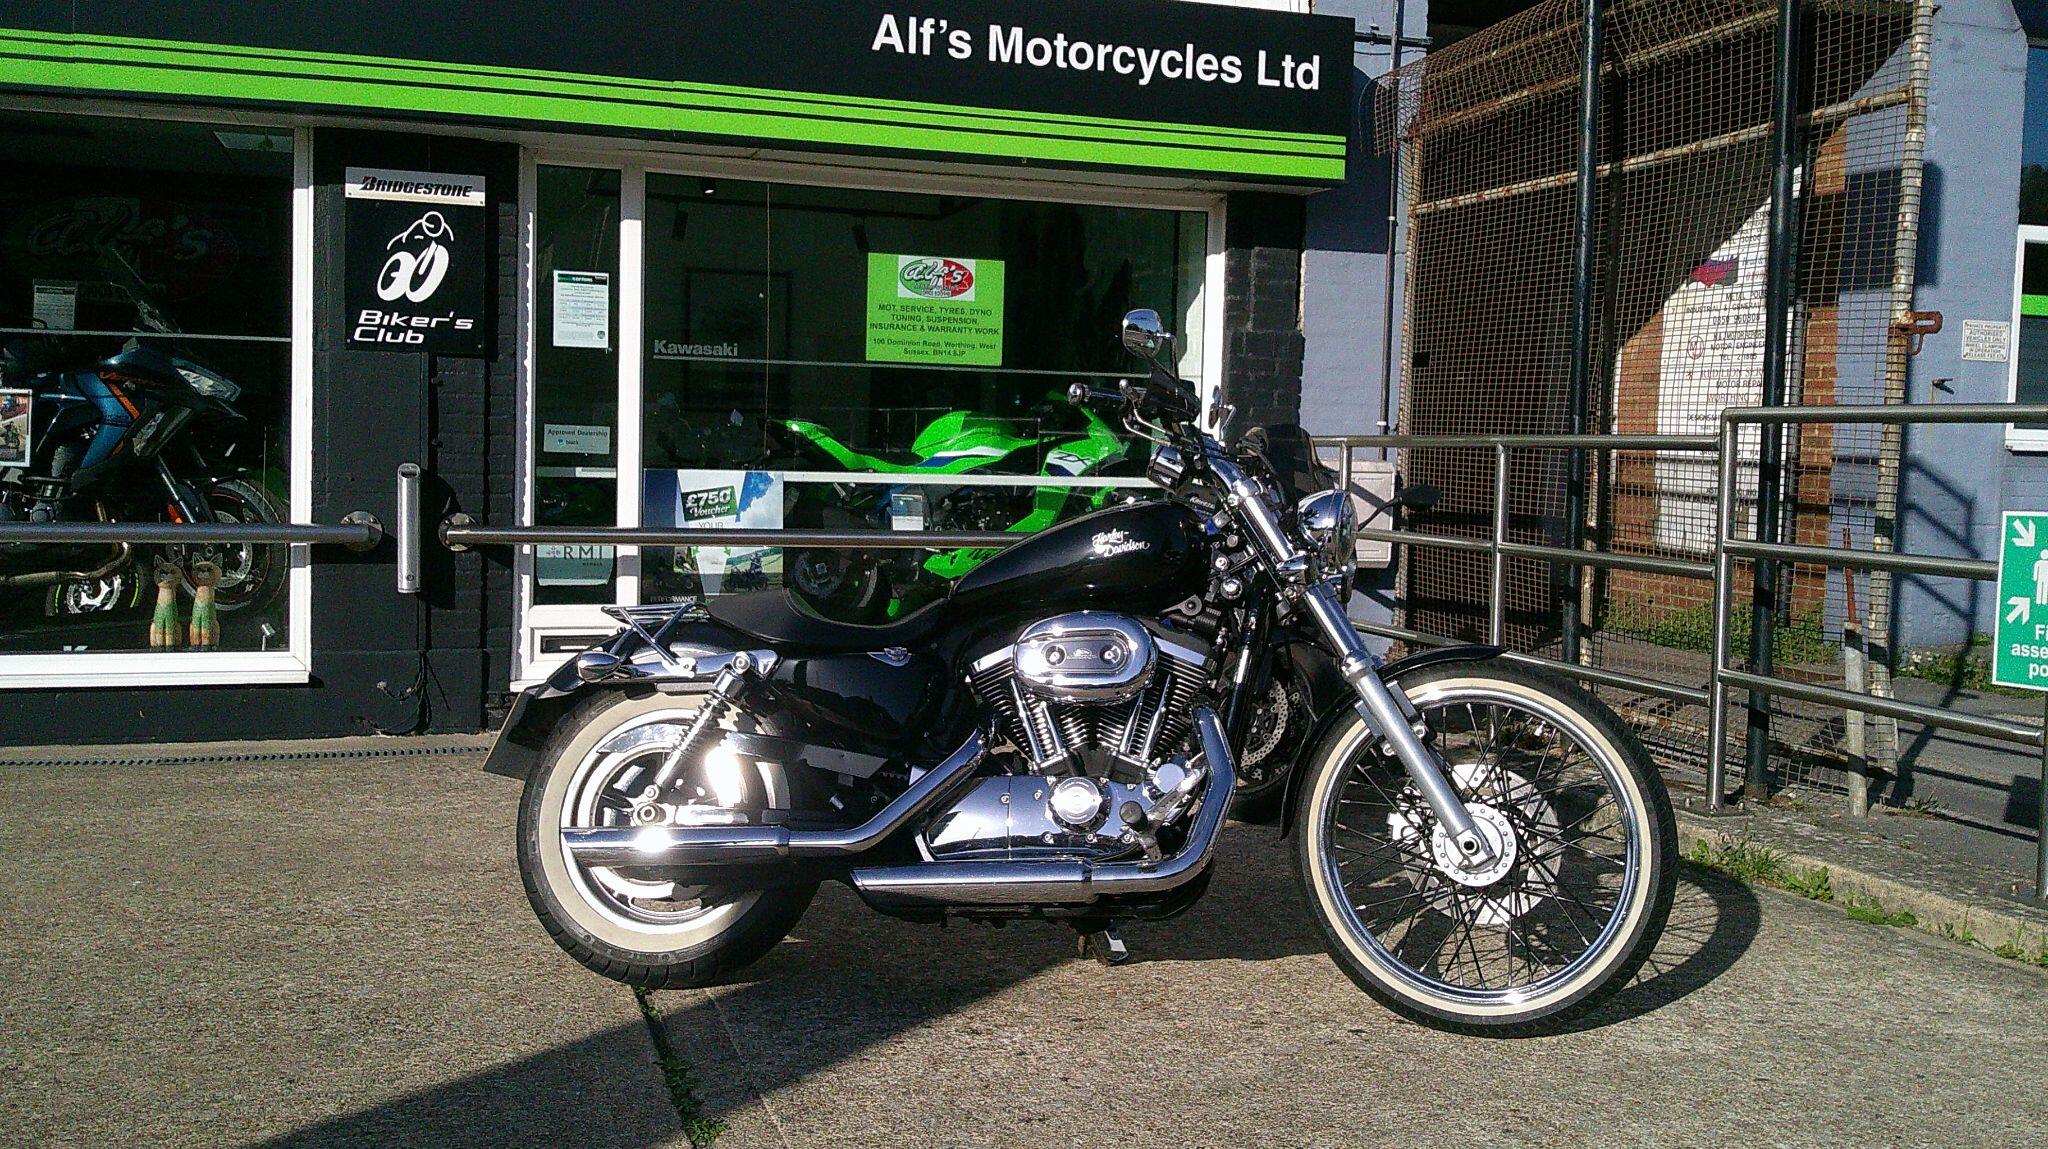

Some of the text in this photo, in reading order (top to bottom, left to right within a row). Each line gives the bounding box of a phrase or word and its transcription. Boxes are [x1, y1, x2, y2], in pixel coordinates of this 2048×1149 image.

[872, 13, 1320, 90] Alf's Motorcycles Ltd
[359, 176, 472, 198] BRIDGESTONE
[900, 305, 937, 314] SERVICE,
[939, 307, 968, 316] TYRES,
[970, 308, 992, 316] DYNO
[358, 310, 474, 330] Biker's
[891, 314, 980, 326] TUNING, SUSPENSION,
[353, 326, 424, 344] Club
[870, 322, 917, 332] INSURANCE
[928, 325, 972, 334] WARRANTY
[654, 340, 738, 356] Kawasaki
[887, 338, 920, 346] Dominion
[578, 430, 608, 438] Dealership
[686, 488, 731, 508] £750
[690, 504, 730, 516] Voucher
[564, 545, 602, 560] RMI
[1104, 540, 1150, 557] Davidson
